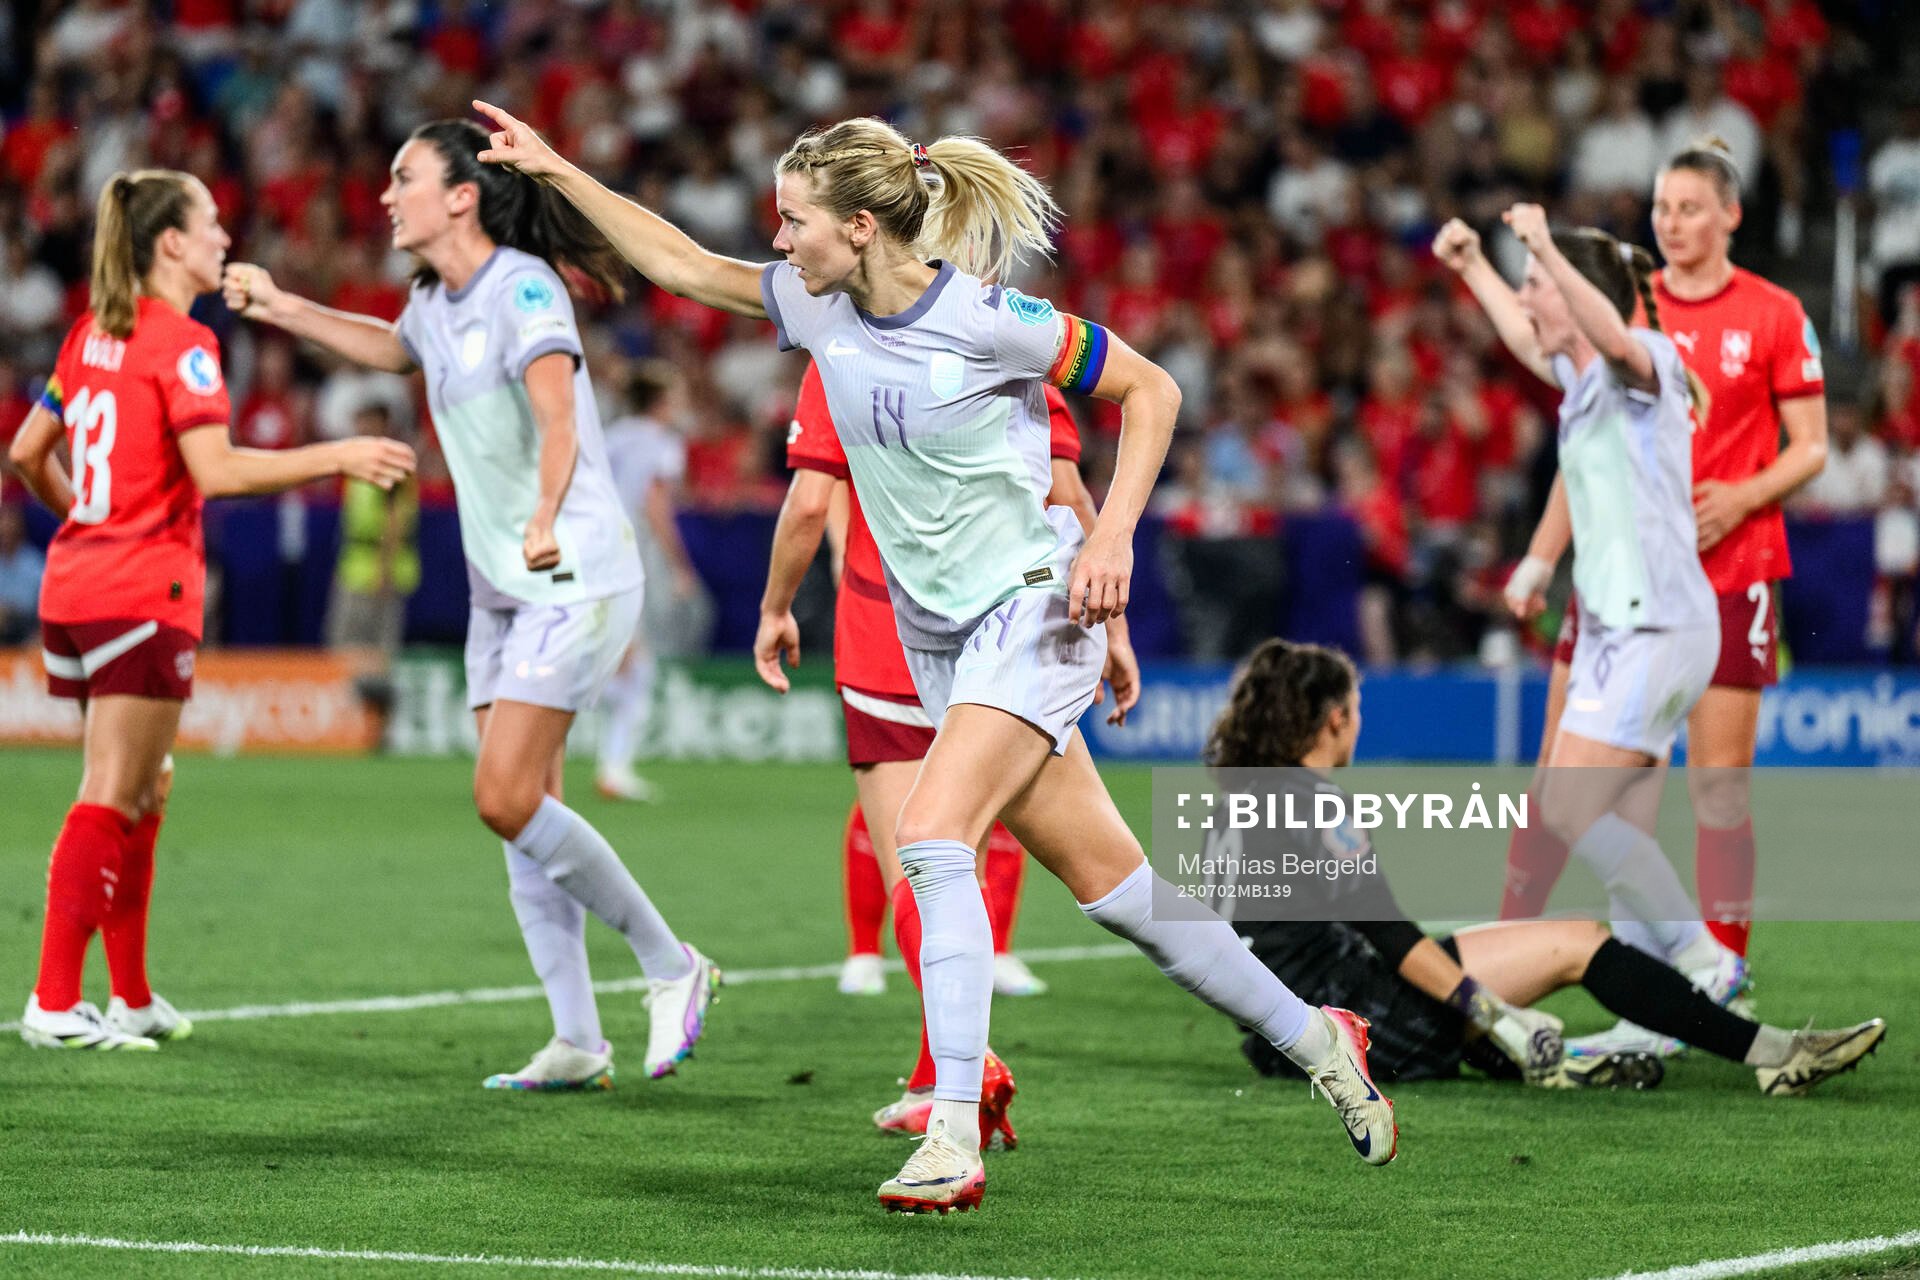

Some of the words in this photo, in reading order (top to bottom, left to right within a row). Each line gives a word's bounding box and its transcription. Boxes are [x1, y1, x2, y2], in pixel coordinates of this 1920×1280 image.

[1066, 337, 1090, 385] RESPECT
[870, 386, 909, 449] 14
[64, 386, 117, 525] 13
[537, 605, 571, 655] 7
[1747, 580, 1769, 645] 2
[1593, 643, 1620, 690] 6
